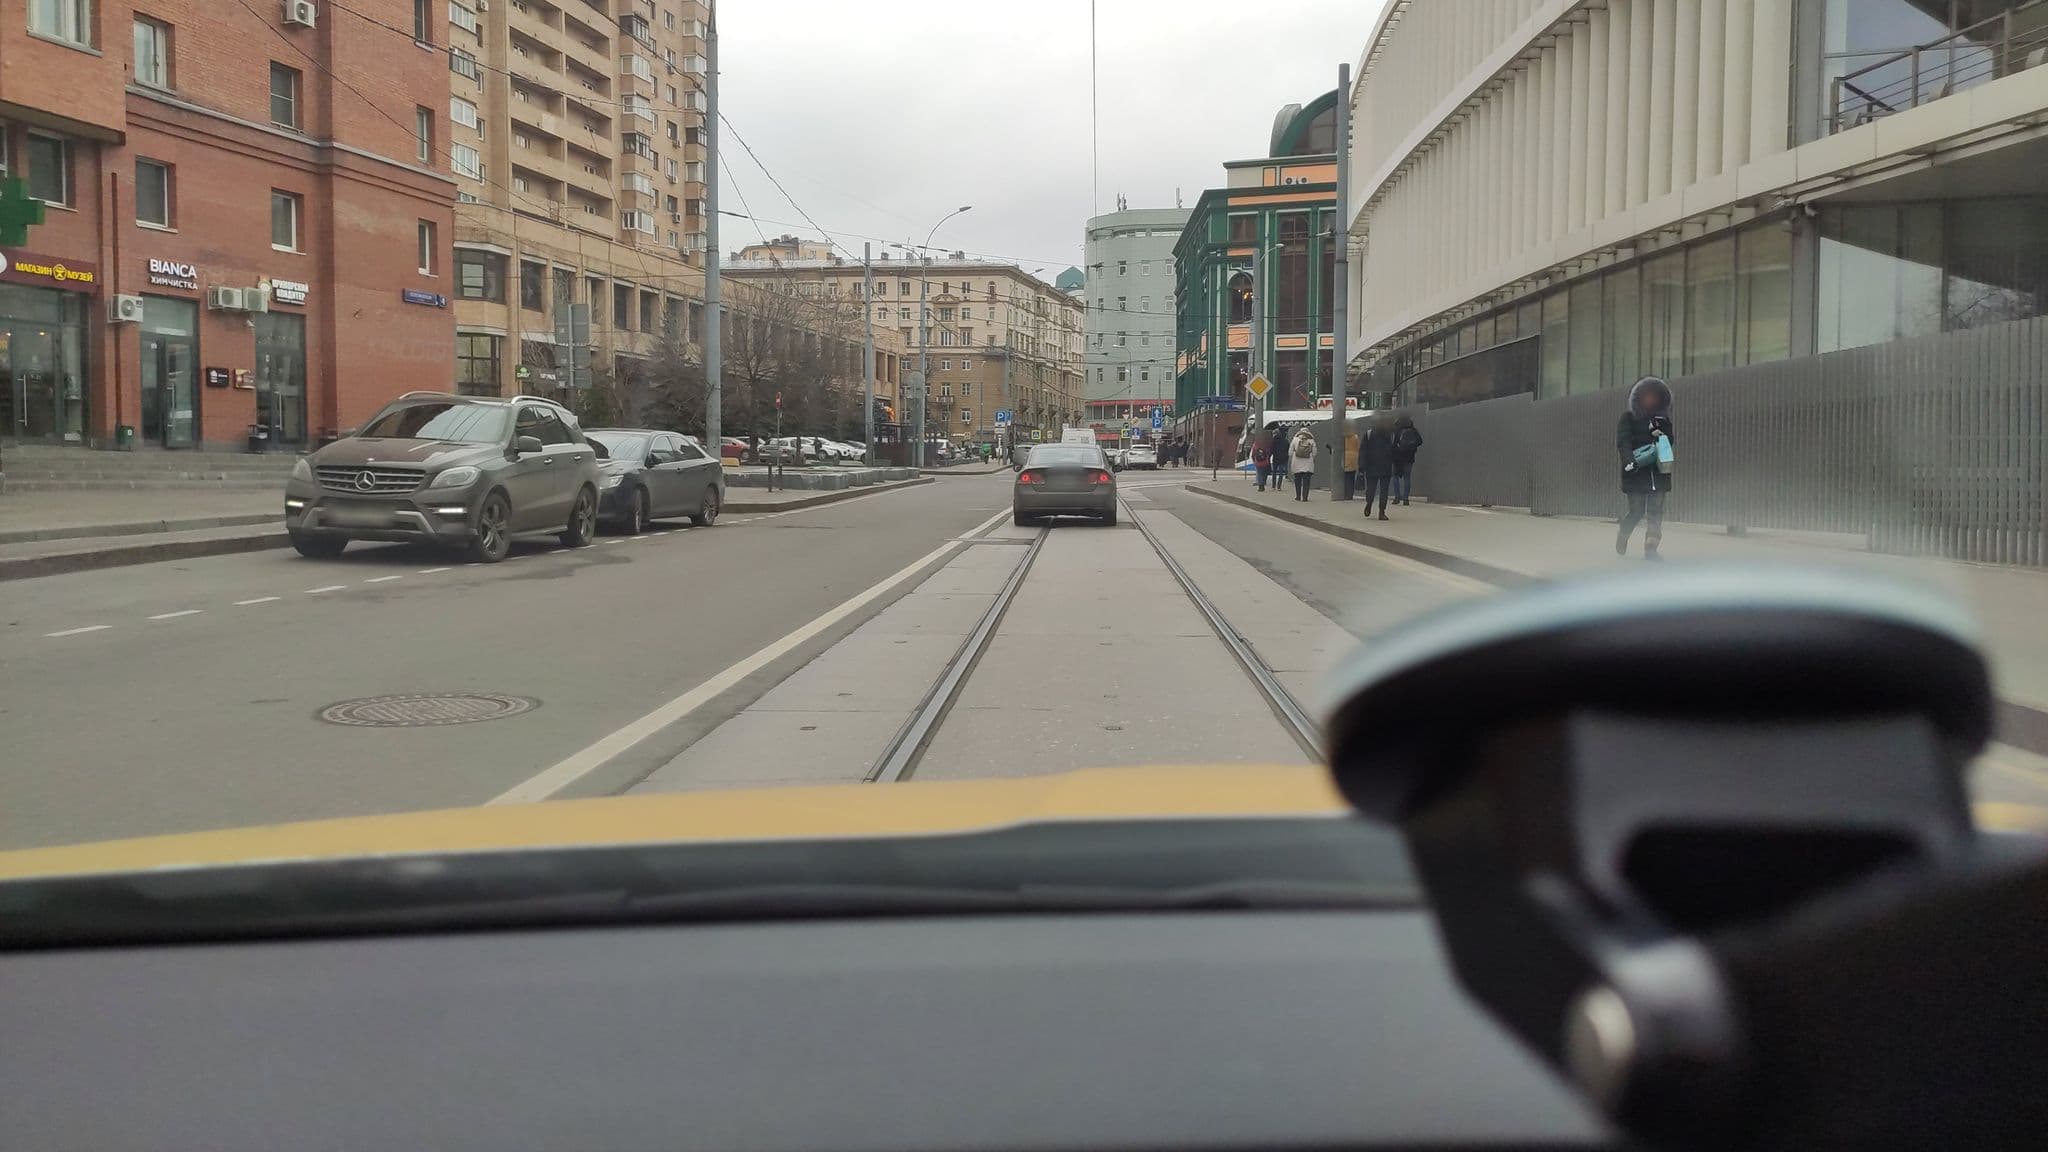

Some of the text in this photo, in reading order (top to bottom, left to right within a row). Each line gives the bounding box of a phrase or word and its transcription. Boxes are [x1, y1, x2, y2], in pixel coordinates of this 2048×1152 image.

[15, 262, 94, 282] МАГАЗИН МУЗЕЙ
[149, 258, 198, 278] BIANCA
[151, 275, 198, 290] ХИМЧИСТКА
